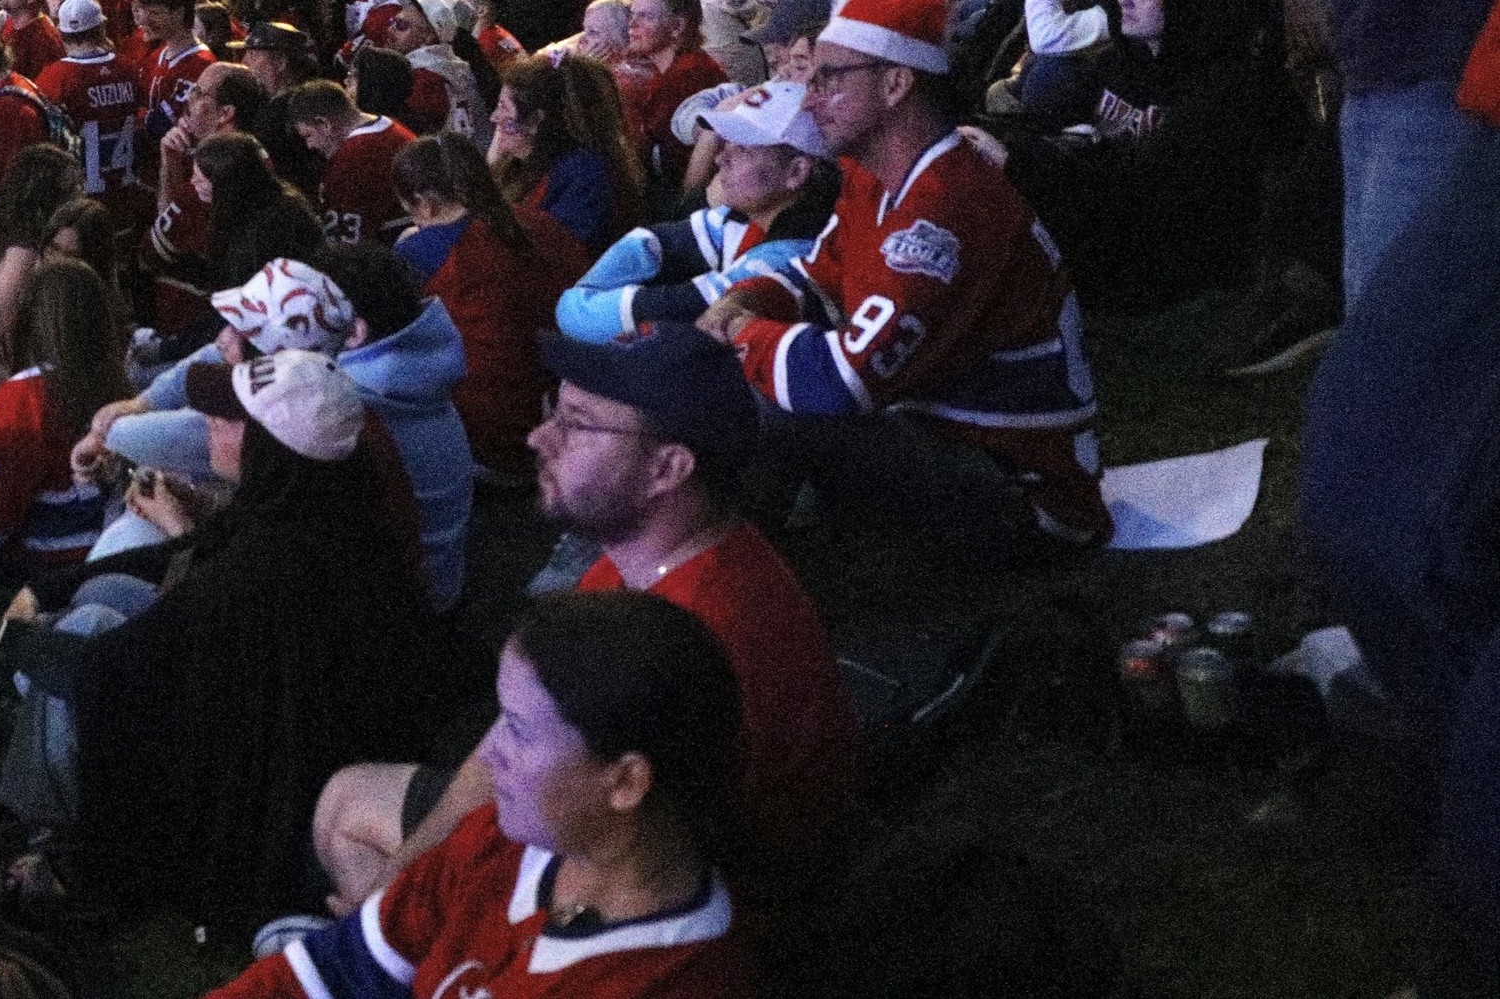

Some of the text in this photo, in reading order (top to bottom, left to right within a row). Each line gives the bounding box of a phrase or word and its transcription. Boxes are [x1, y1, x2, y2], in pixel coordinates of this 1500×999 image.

[88, 82, 134, 108] SUZUKI
[81, 114, 135, 194] 14
[322, 210, 362, 245] 23
